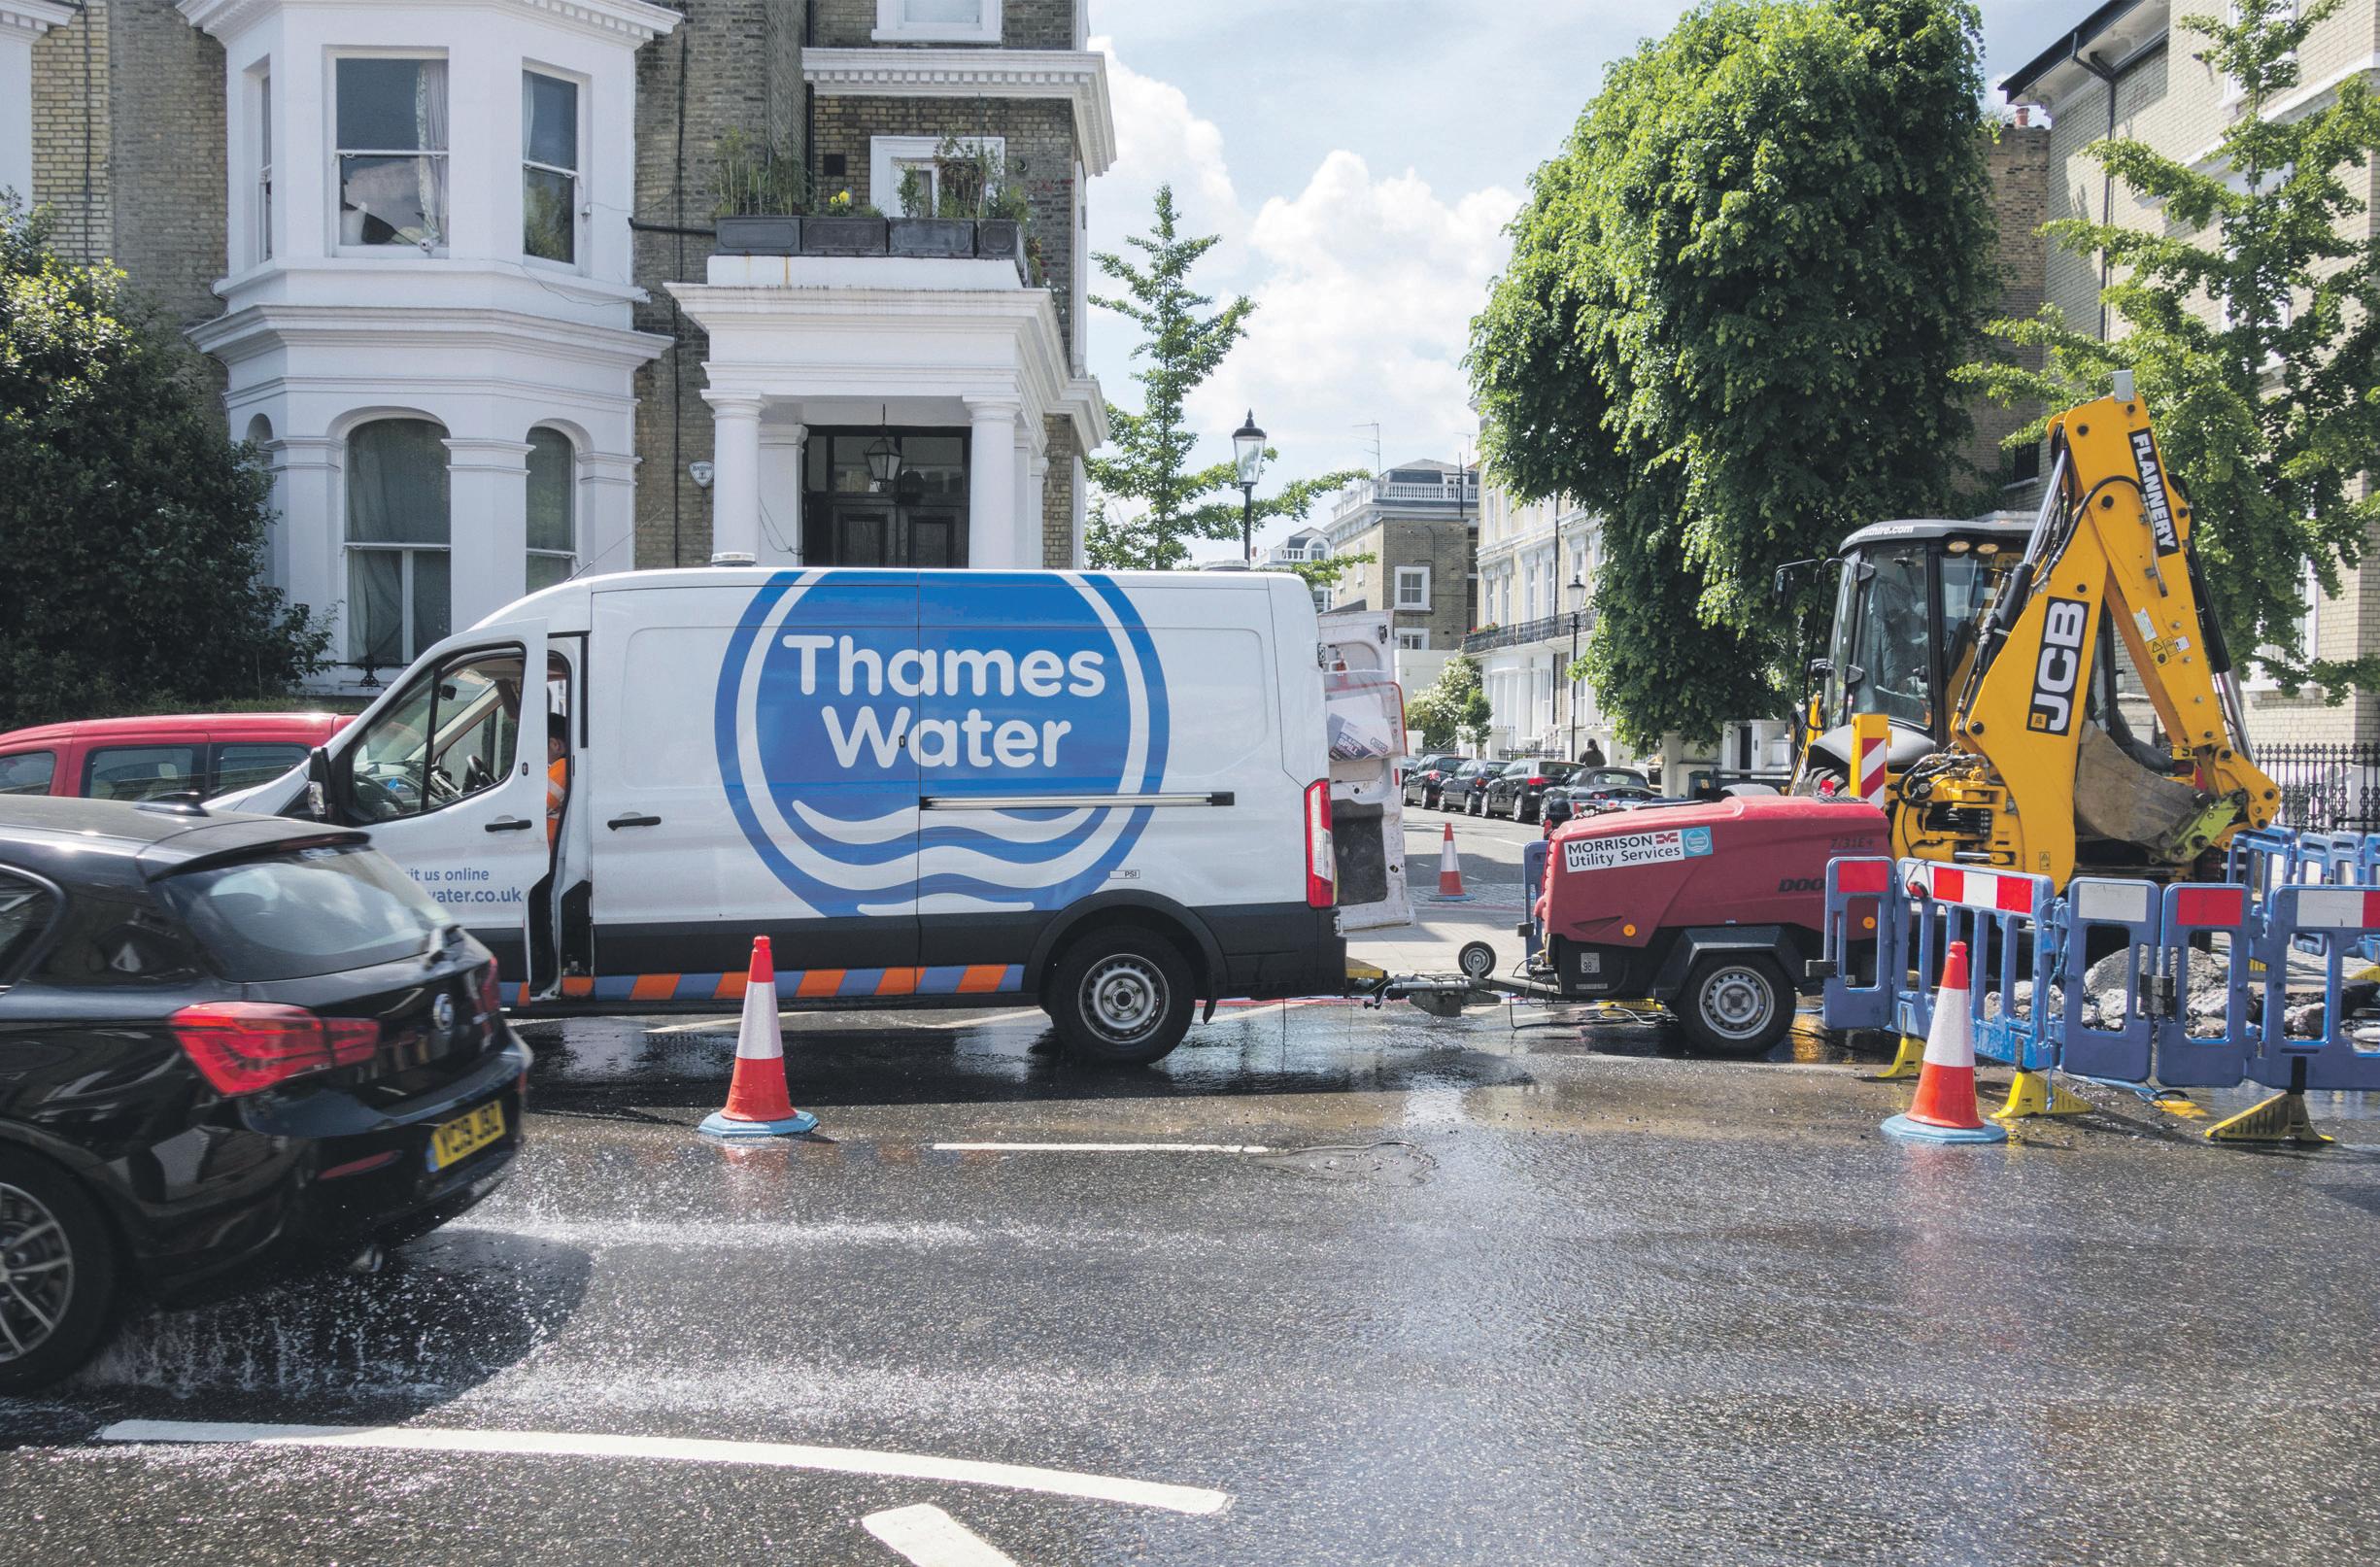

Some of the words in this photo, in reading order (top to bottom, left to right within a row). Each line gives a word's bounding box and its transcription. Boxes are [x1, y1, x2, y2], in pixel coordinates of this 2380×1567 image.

[2132, 433, 2176, 547] FLANNERY
[782, 634, 1105, 698] Thames
[2034, 601, 2085, 732] JCB
[821, 705, 1071, 768] Water
[1338, 737, 1358, 756] SPILL
[1568, 835, 1652, 855] MORRISON
[1569, 853, 1615, 868] Utility
[1621, 846, 1681, 862] Services
[407, 869, 420, 881] it
[425, 870, 440, 881] us
[444, 868, 490, 881] online
[1583, 962, 1592, 971] 98
